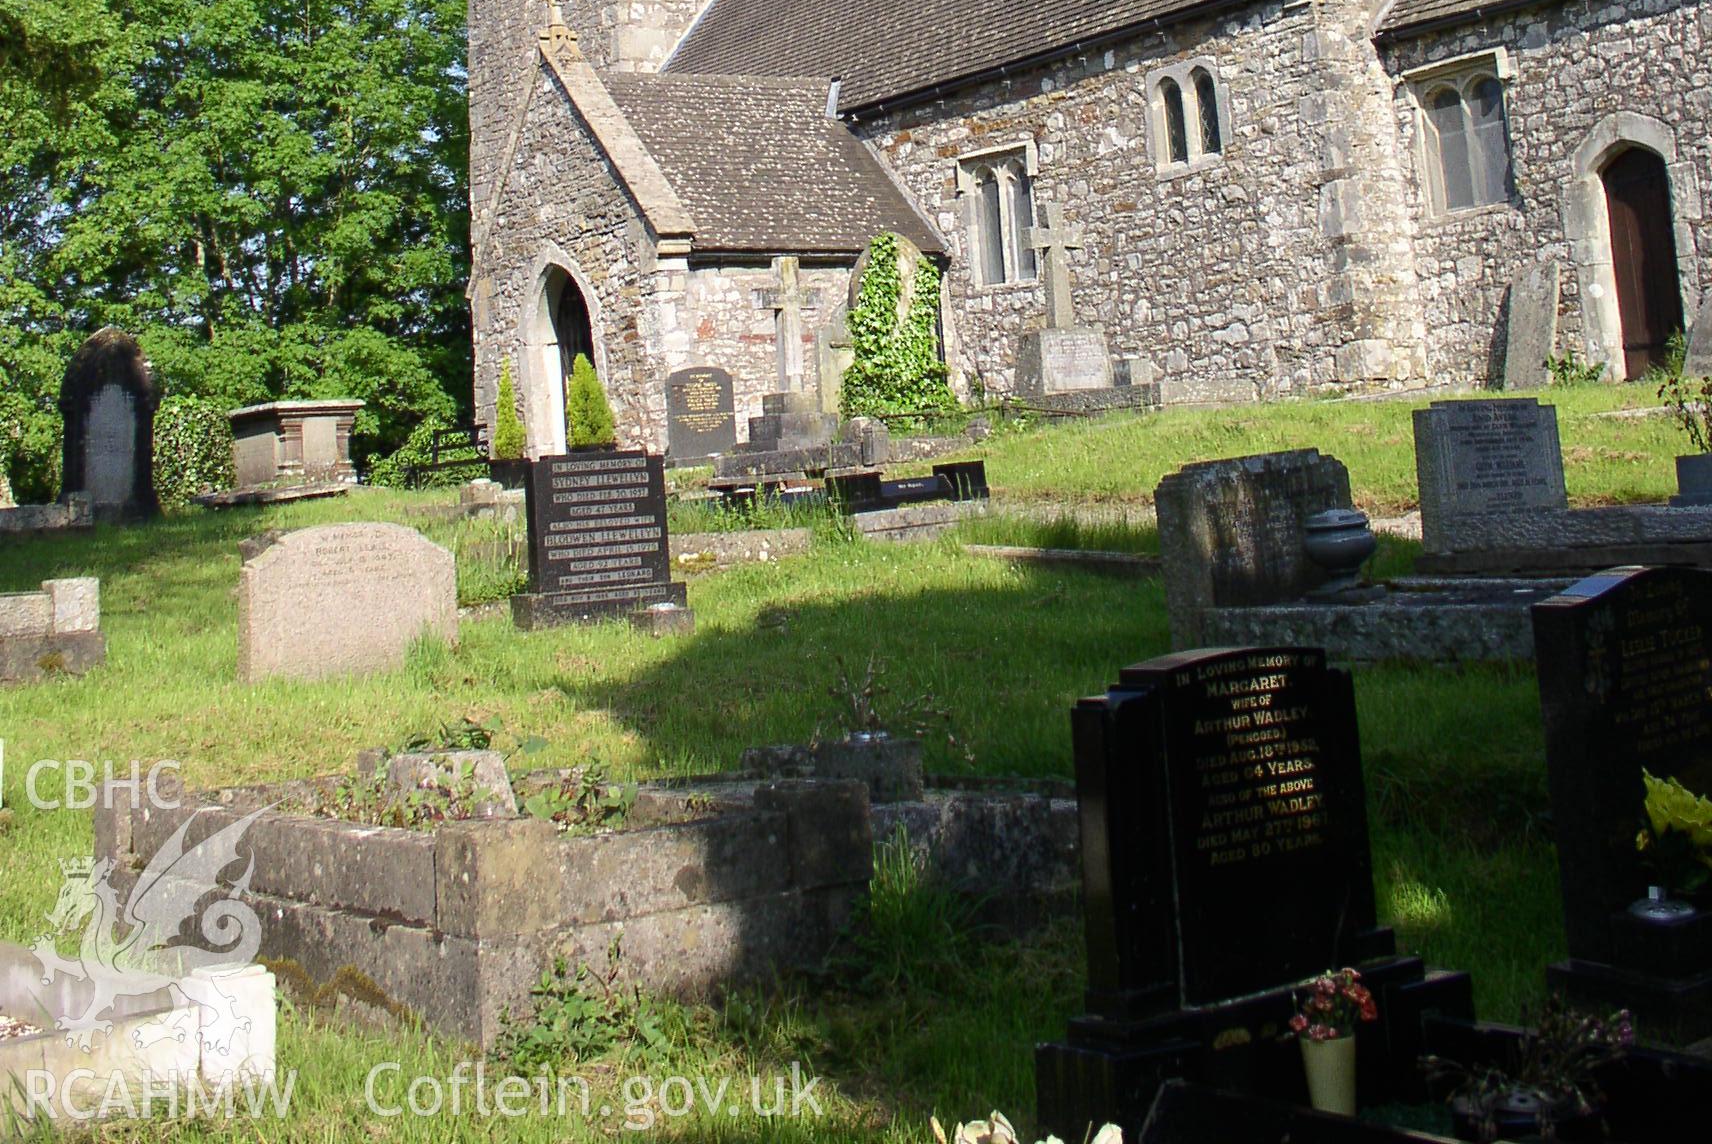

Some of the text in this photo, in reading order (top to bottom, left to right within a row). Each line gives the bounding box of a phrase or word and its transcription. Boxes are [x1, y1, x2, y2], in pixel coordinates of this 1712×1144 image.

[566, 461, 596, 471] LOVING
[599, 458, 631, 469] MEMORY
[553, 472, 648, 488] SYDNEY LLEWELLYN
[546, 527, 660, 545] BLODWEN LLEWELLYN
[1176, 672, 1191, 687] IN
[1196, 659, 1246, 681] LOVING
[1247, 655, 1298, 670] MEMORY
[1231, 694, 1272, 710] WIFE OF
[1194, 715, 1251, 736] ARTHUR
[1195, 754, 1227, 770] DIED
[1201, 771, 1238, 789] AGED
[1238, 789, 1253, 801] OF
[1256, 784, 1277, 797] THE
[1279, 778, 1314, 794] ABOVE
[1202, 805, 1264, 829] ARTHUR
[1197, 833, 1227, 849] DIED
[1231, 825, 1260, 843] MAY
[1210, 847, 1246, 867] AGED
